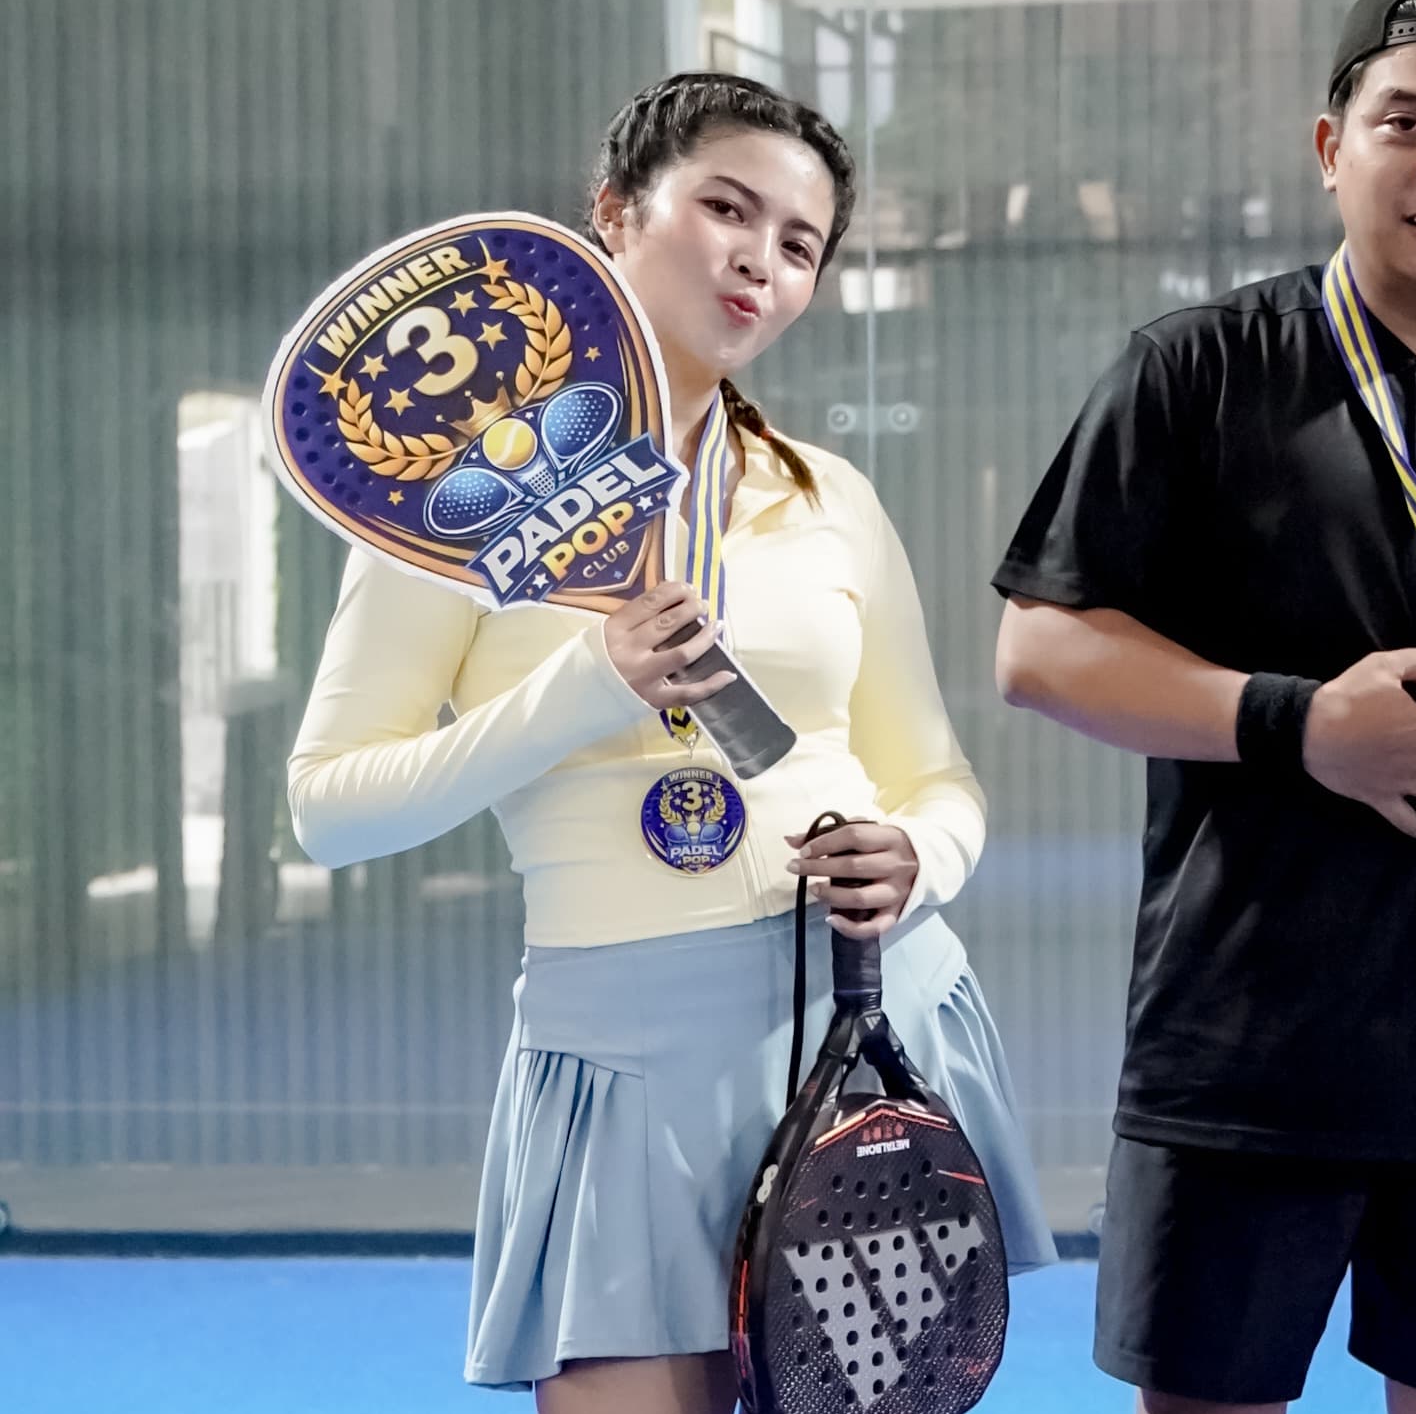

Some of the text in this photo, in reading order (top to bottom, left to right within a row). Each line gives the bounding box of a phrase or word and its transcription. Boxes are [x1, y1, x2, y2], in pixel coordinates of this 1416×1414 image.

[386, 306, 479, 397] 3
[480, 452, 668, 594] PADEL
[540, 500, 635, 582] POP
[582, 540, 630, 580] CLUB
[668, 769, 714, 782] WINNER
[682, 782, 704, 812] 3
[669, 844, 723, 860] PADEL
[682, 854, 711, 865] POP
[856, 1138, 910, 1158] METALBONE
